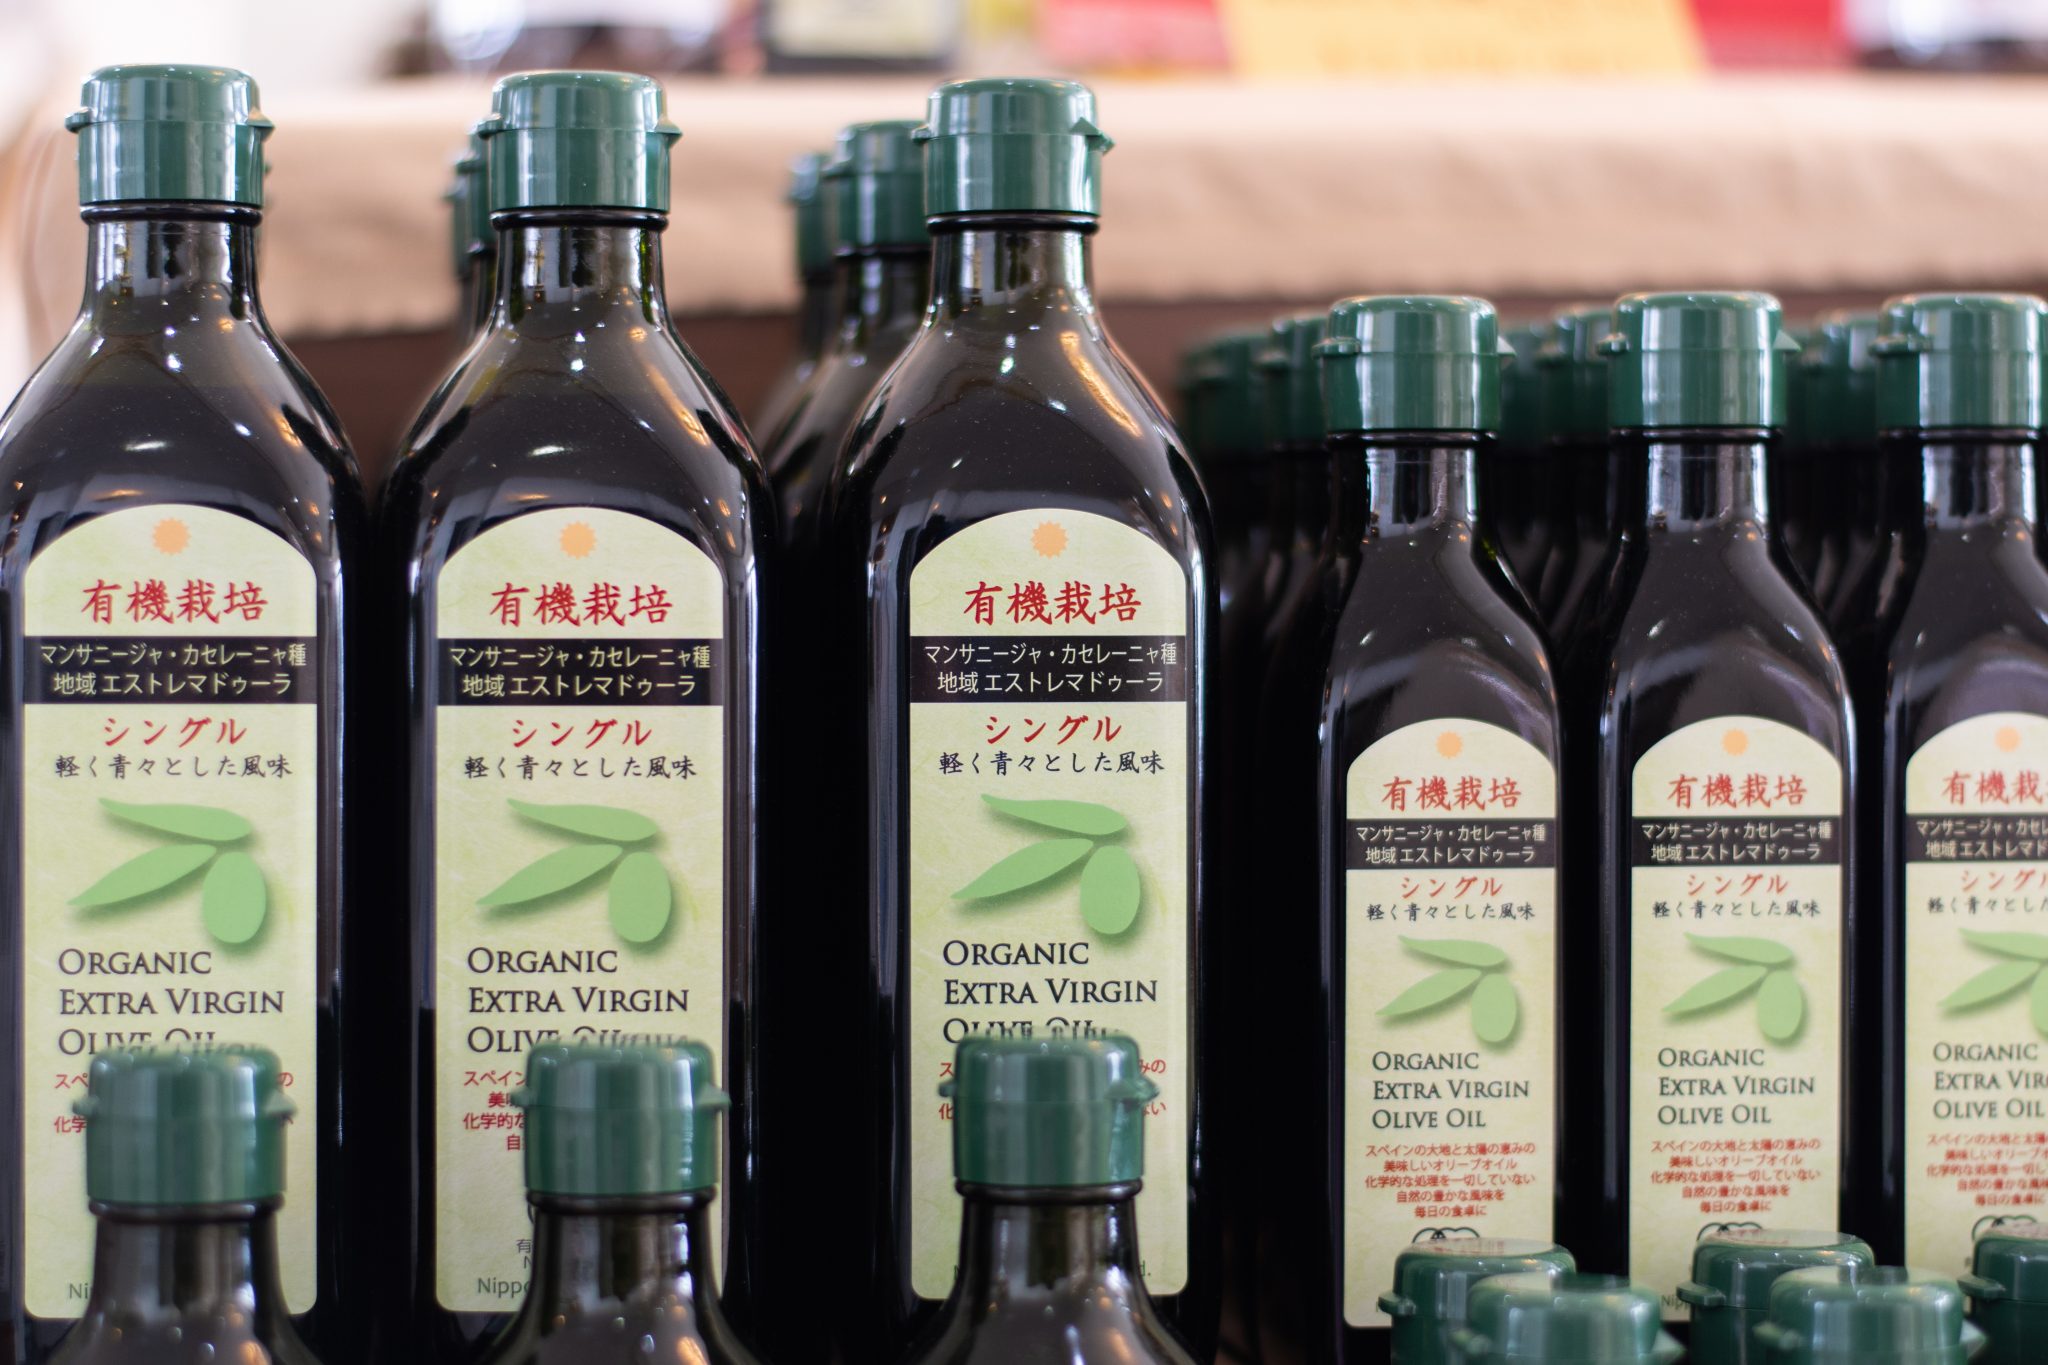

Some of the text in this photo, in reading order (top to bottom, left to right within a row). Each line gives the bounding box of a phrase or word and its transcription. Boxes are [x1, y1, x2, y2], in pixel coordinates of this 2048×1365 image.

[82, 579, 267, 624] 有機栽培
[491, 582, 672, 626] 有機栽培
[964, 581, 1141, 625] 有機栽培
[41, 643, 307, 666] マンサニージャ・カセレーニャ種
[450, 646, 711, 668] マンサニージャ・カセレーニャ種
[925, 642, 1177, 664] マンサニージャ・カセレーニャ種
[54, 673, 290, 694] 地域 エストレマドゥーラ
[463, 675, 695, 696] 地域 エストレマドゥーラ
[938, 671, 1163, 693] 地域 エストレマドゥーラ
[105, 718, 246, 747] シングル
[513, 719, 651, 748] シングル
[987, 715, 1121, 744] シングル
[56, 754, 292, 779] 軽く青々とした風味
[465, 755, 696, 780] 軽く青々とした風味
[939, 751, 1164, 775] 軽く青々とした風味
[1383, 776, 1521, 811] 有機栽培
[1669, 774, 1806, 808] 有機栽培
[1942, 770, 2048, 805] 有機栽
[1402, 877, 1502, 899] シングル
[1688, 874, 1787, 896] シングル
[59, 949, 211, 975] ORGANIC
[468, 947, 617, 973] ORGANIC
[943, 940, 1088, 965] ORGANIC
[60, 989, 283, 1014] EXTRA VIRGIN
[469, 987, 688, 1012] EXTRA VIRGIN
[944, 978, 1157, 1004] EXTRA VIRGIN
[1372, 1051, 1478, 1071] ORGANIC
[1658, 1048, 1763, 1067] ORGANIC
[1933, 1043, 2037, 1061] ORGANIC
[1374, 1080, 1528, 1100] EXTRA VIRGIN
[1660, 1076, 1814, 1096] EXTRA VIRGIN
[1935, 1072, 2000, 1090] EXTRA
[1372, 1108, 1486, 1129] OLIVE OIL
[1658, 1105, 1771, 1125] OLIVE OIL
[1933, 1099, 2044, 1119] OLIVE OIL
